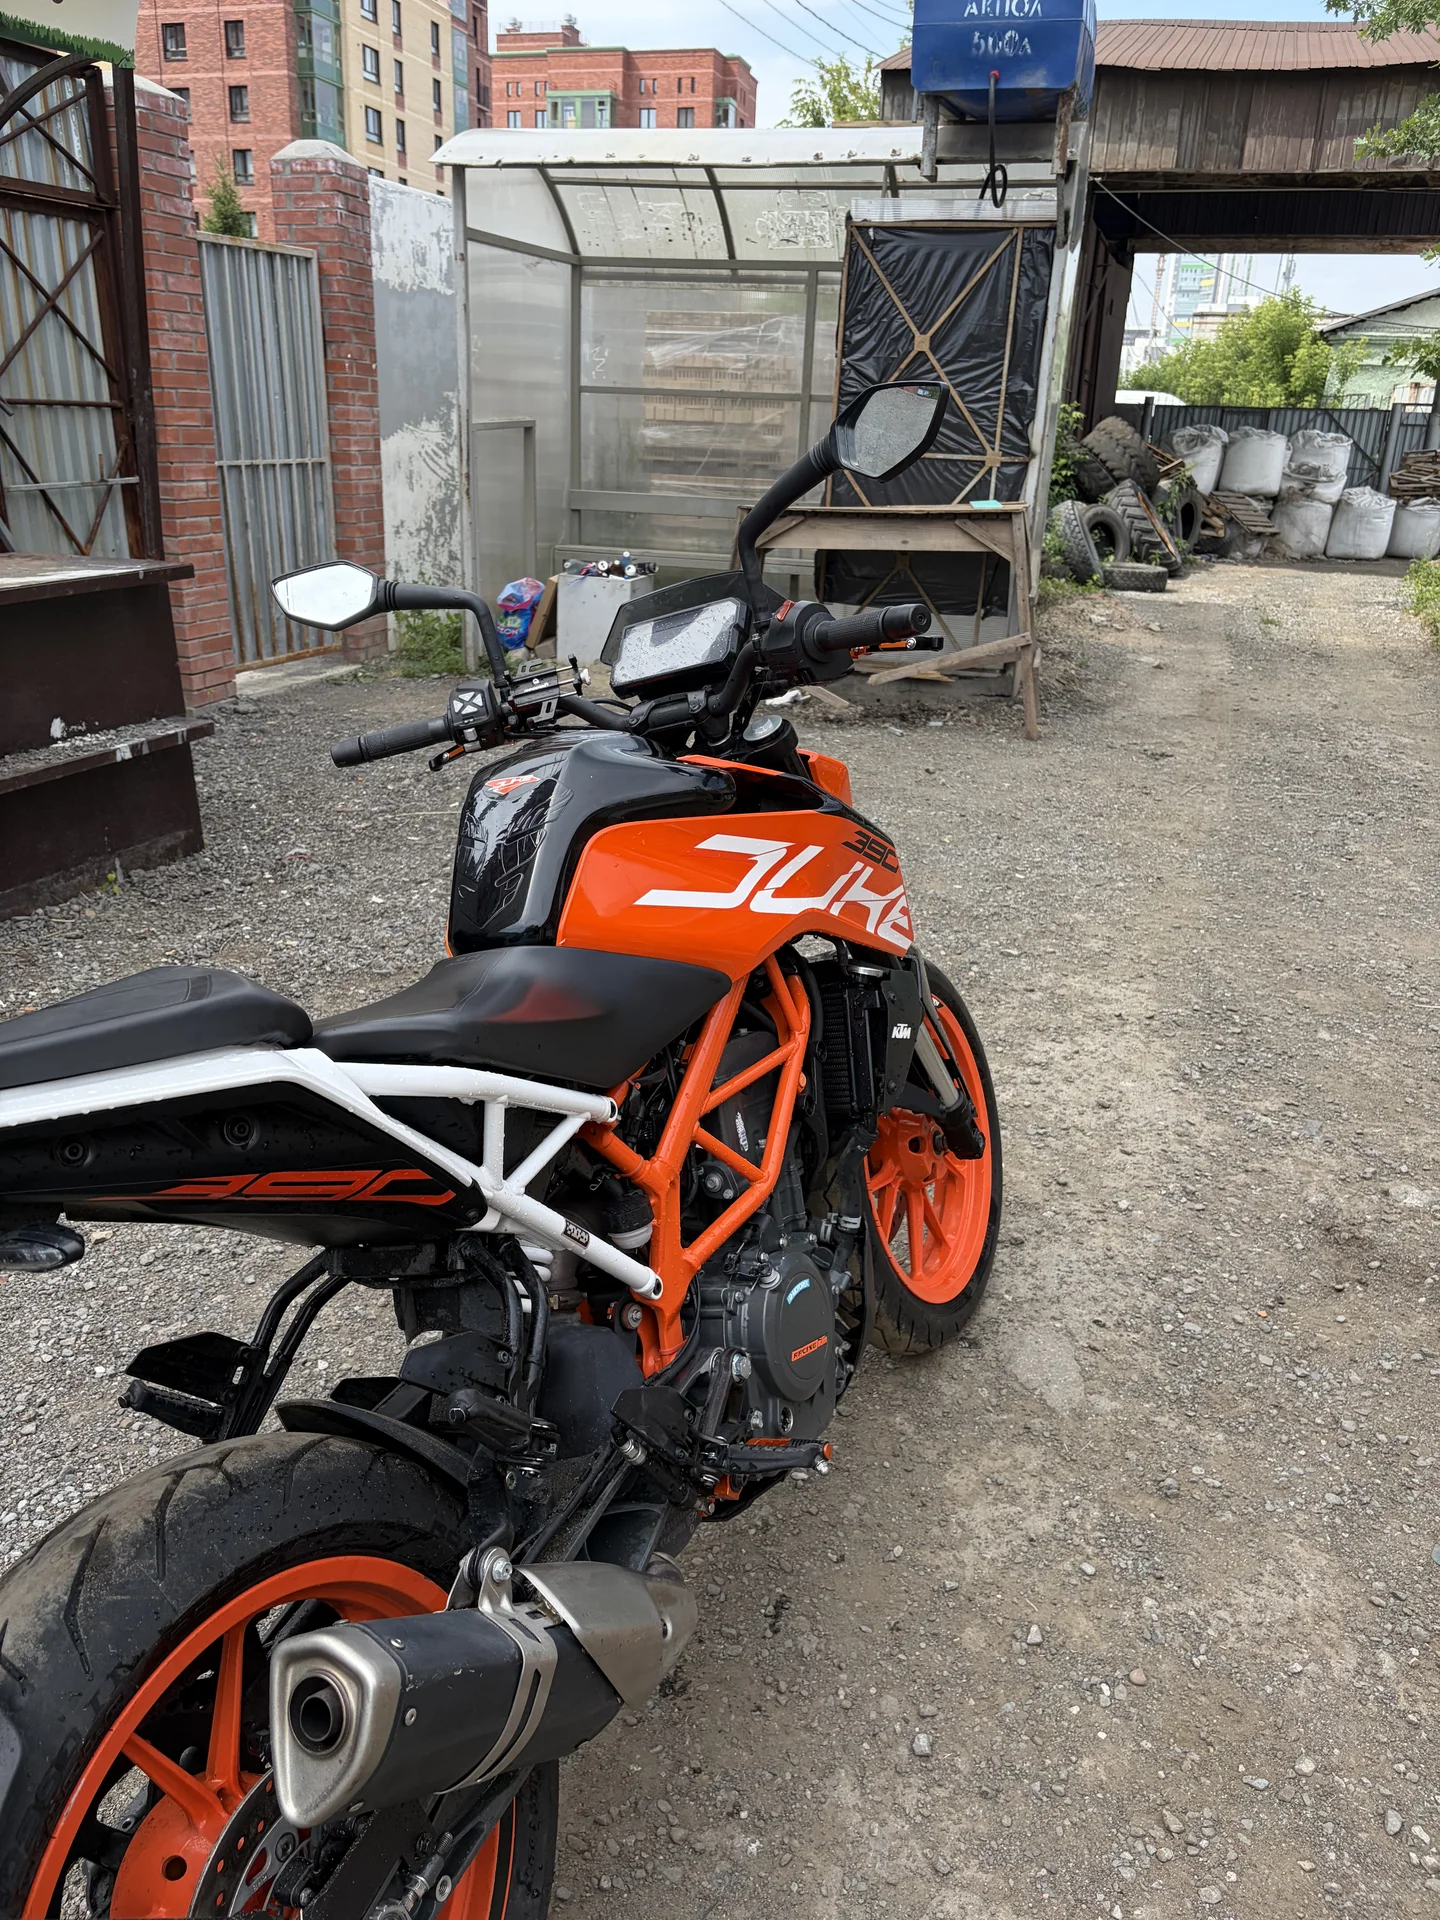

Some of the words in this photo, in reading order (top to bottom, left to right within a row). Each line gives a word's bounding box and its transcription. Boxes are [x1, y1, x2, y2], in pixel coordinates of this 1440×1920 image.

[841, 830, 899, 873] 390
[633, 833, 913, 950] DUKE
[891, 1023, 911, 1039] KTM
[140, 1169, 456, 1205] 390
